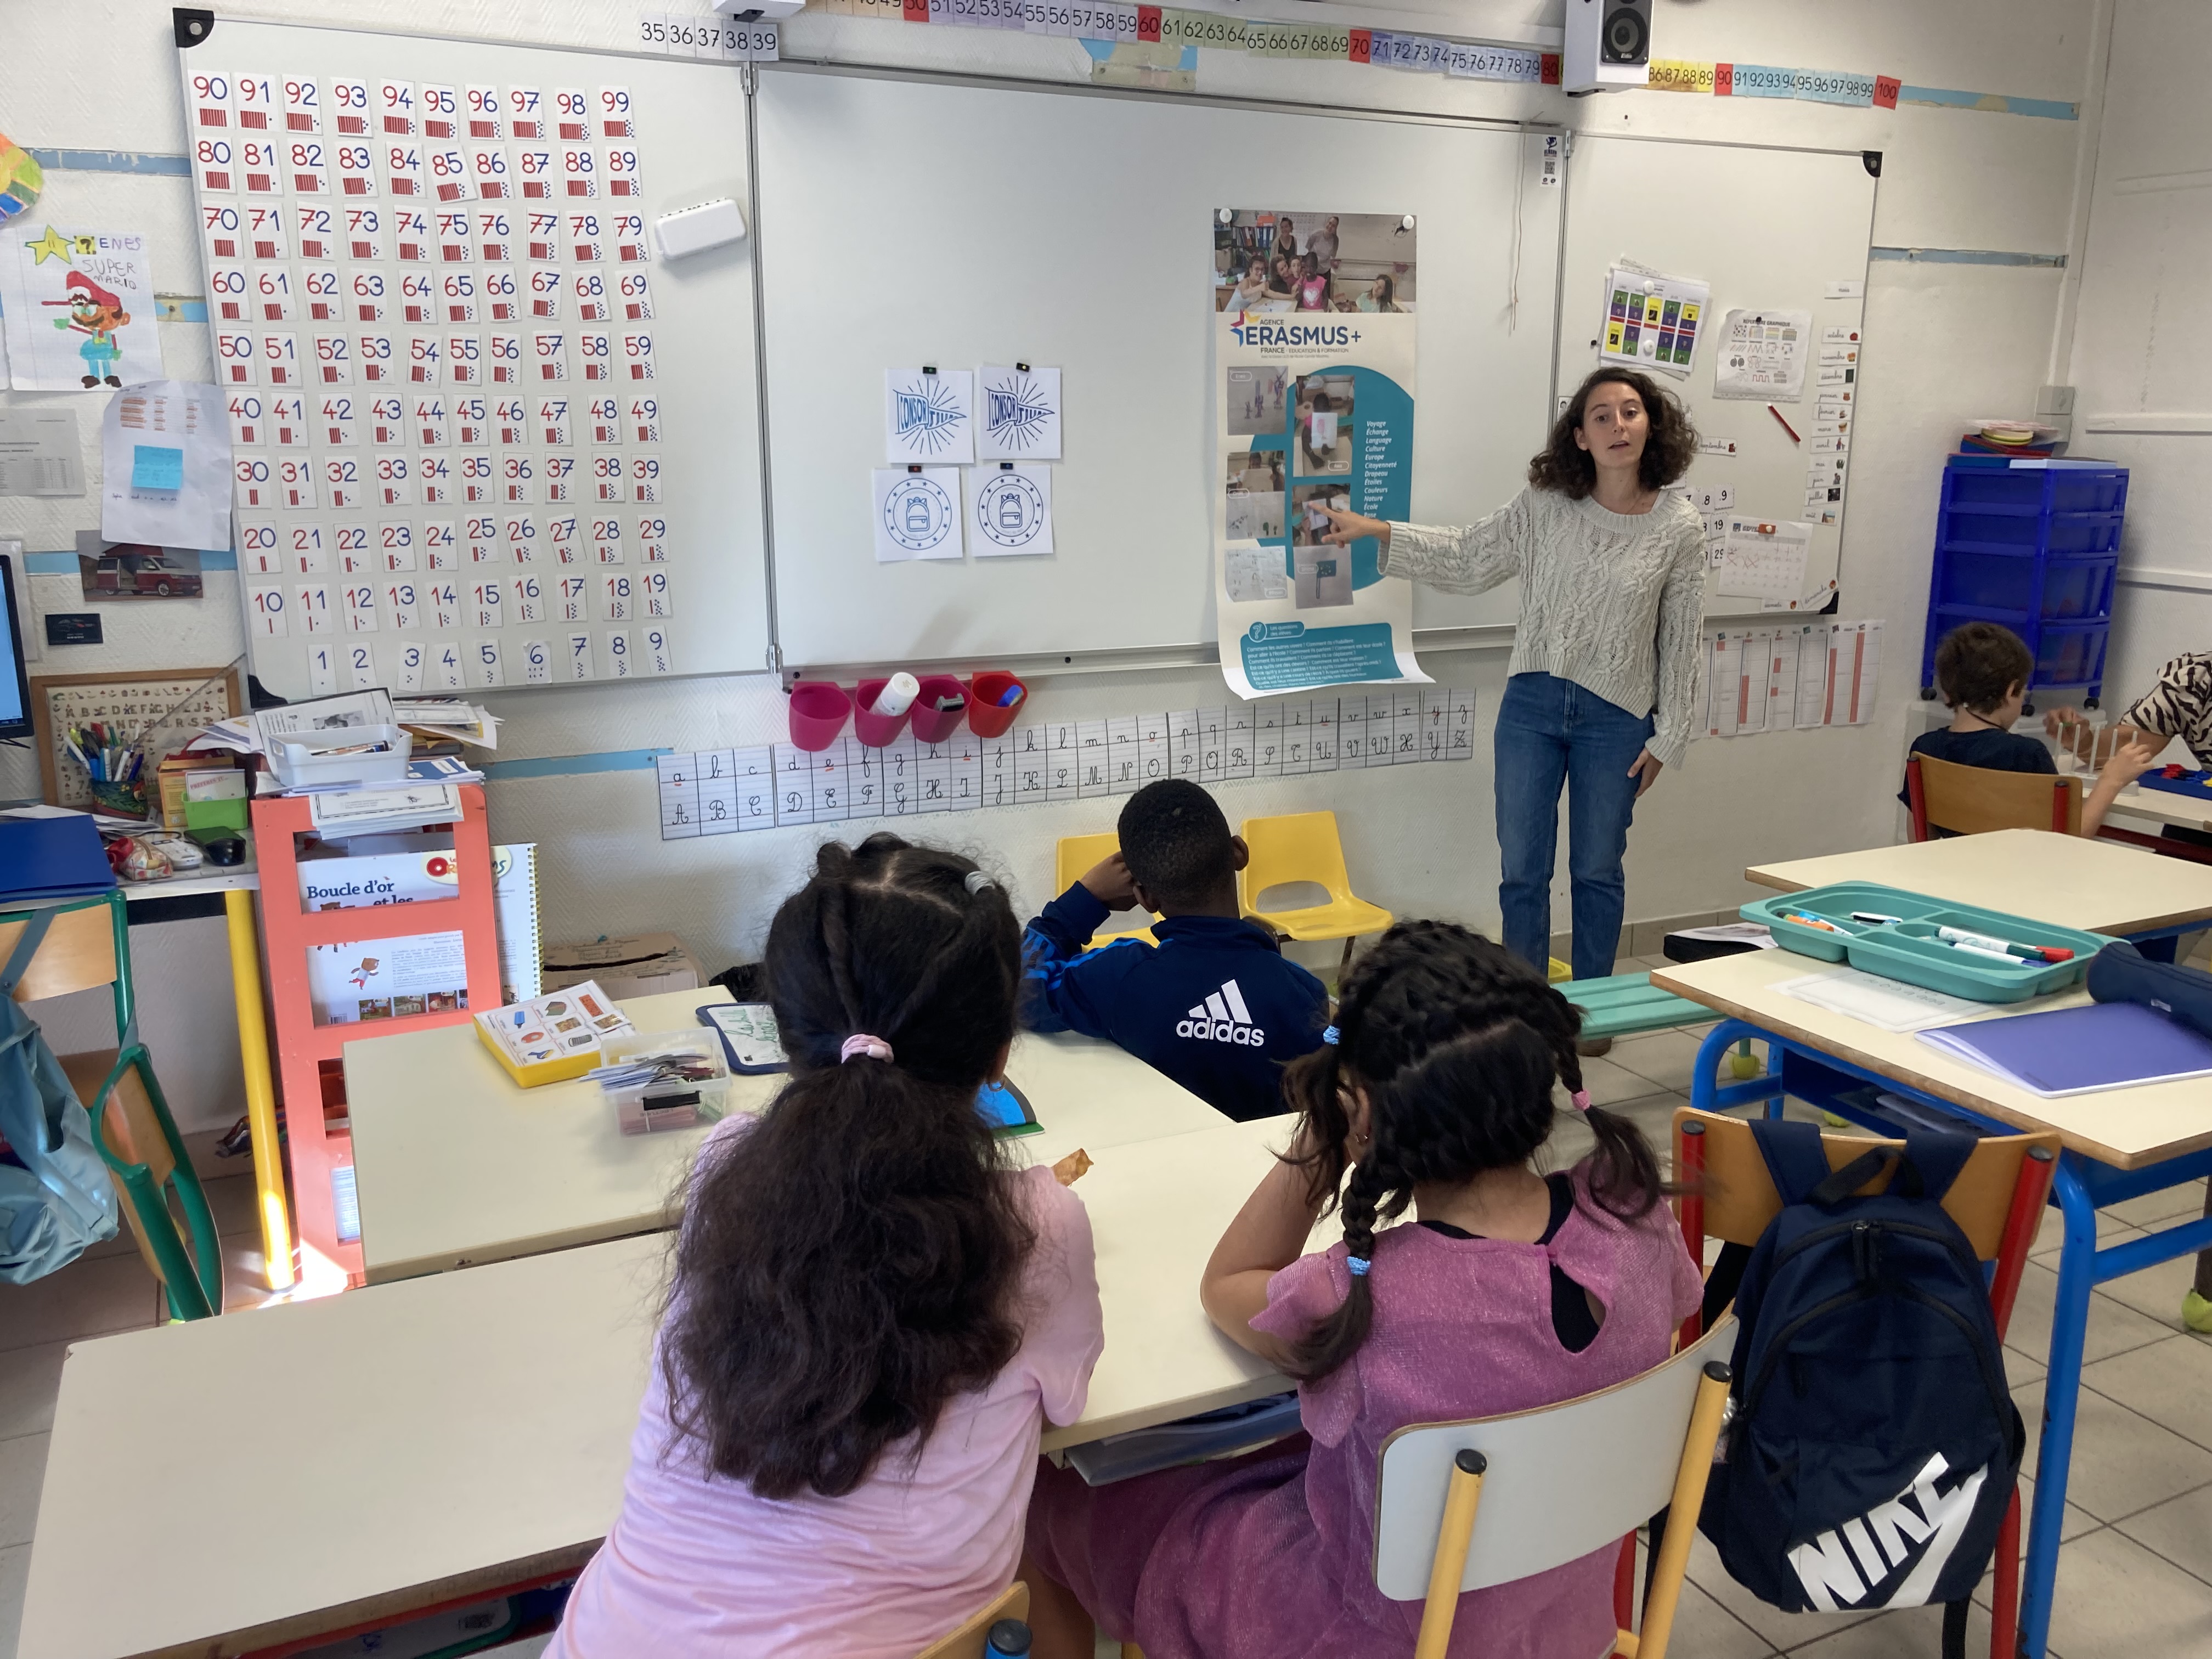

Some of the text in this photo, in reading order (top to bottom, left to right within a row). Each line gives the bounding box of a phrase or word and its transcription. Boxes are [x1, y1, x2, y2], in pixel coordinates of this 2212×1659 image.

[642, 22, 775, 49] 35 36 37 38 39
[1026, 5, 1369, 54] 55 56 57 58 59 60 65 66 67 68 69 70
[1452, 53, 1559, 77] 75 76 77 78 79 80
[194, 76, 629, 115] 90 91 92 93 94 95 96 97 98 99
[1798, 76, 1897, 99] 95 96 97 98 99 100
[100, 238, 141, 251] ENES
[82, 258, 136, 276] SUPER
[94, 275, 137, 290] MARIO
[219, 336, 651, 362] 50 51 52 53 54 55 56 57 58 59
[1366, 428, 1389, 436] Échange
[1365, 461, 1397, 470] Citoyenneté
[1714, 520, 1723, 530] 19
[256, 574, 665, 612] 10 11 12 13 14 15 16 17 18 19
[318, 633, 662, 669] 1 2 3 4 5 6 7 8 9
[674, 774, 685, 782] a
[709, 755, 722, 778] b
[749, 766, 757, 775] c
[789, 755, 800, 770] d
[825, 758, 834, 768] e
[894, 754, 905, 776] g
[962, 745, 970, 758] i
[994, 746, 1005, 768] j
[1024, 730, 1037, 752] k
[1057, 727, 1069, 749] l
[1084, 739, 1102, 747] m
[1116, 735, 1131, 743] n
[1209, 724, 1218, 744] q
[1294, 712, 1301, 725] t
[1432, 707, 1441, 725] y
[1458, 705, 1468, 724] z
[307, 884, 360, 899] Boucle
[373, 895, 414, 906] et les
[1176, 1017, 1265, 1047] adidas
